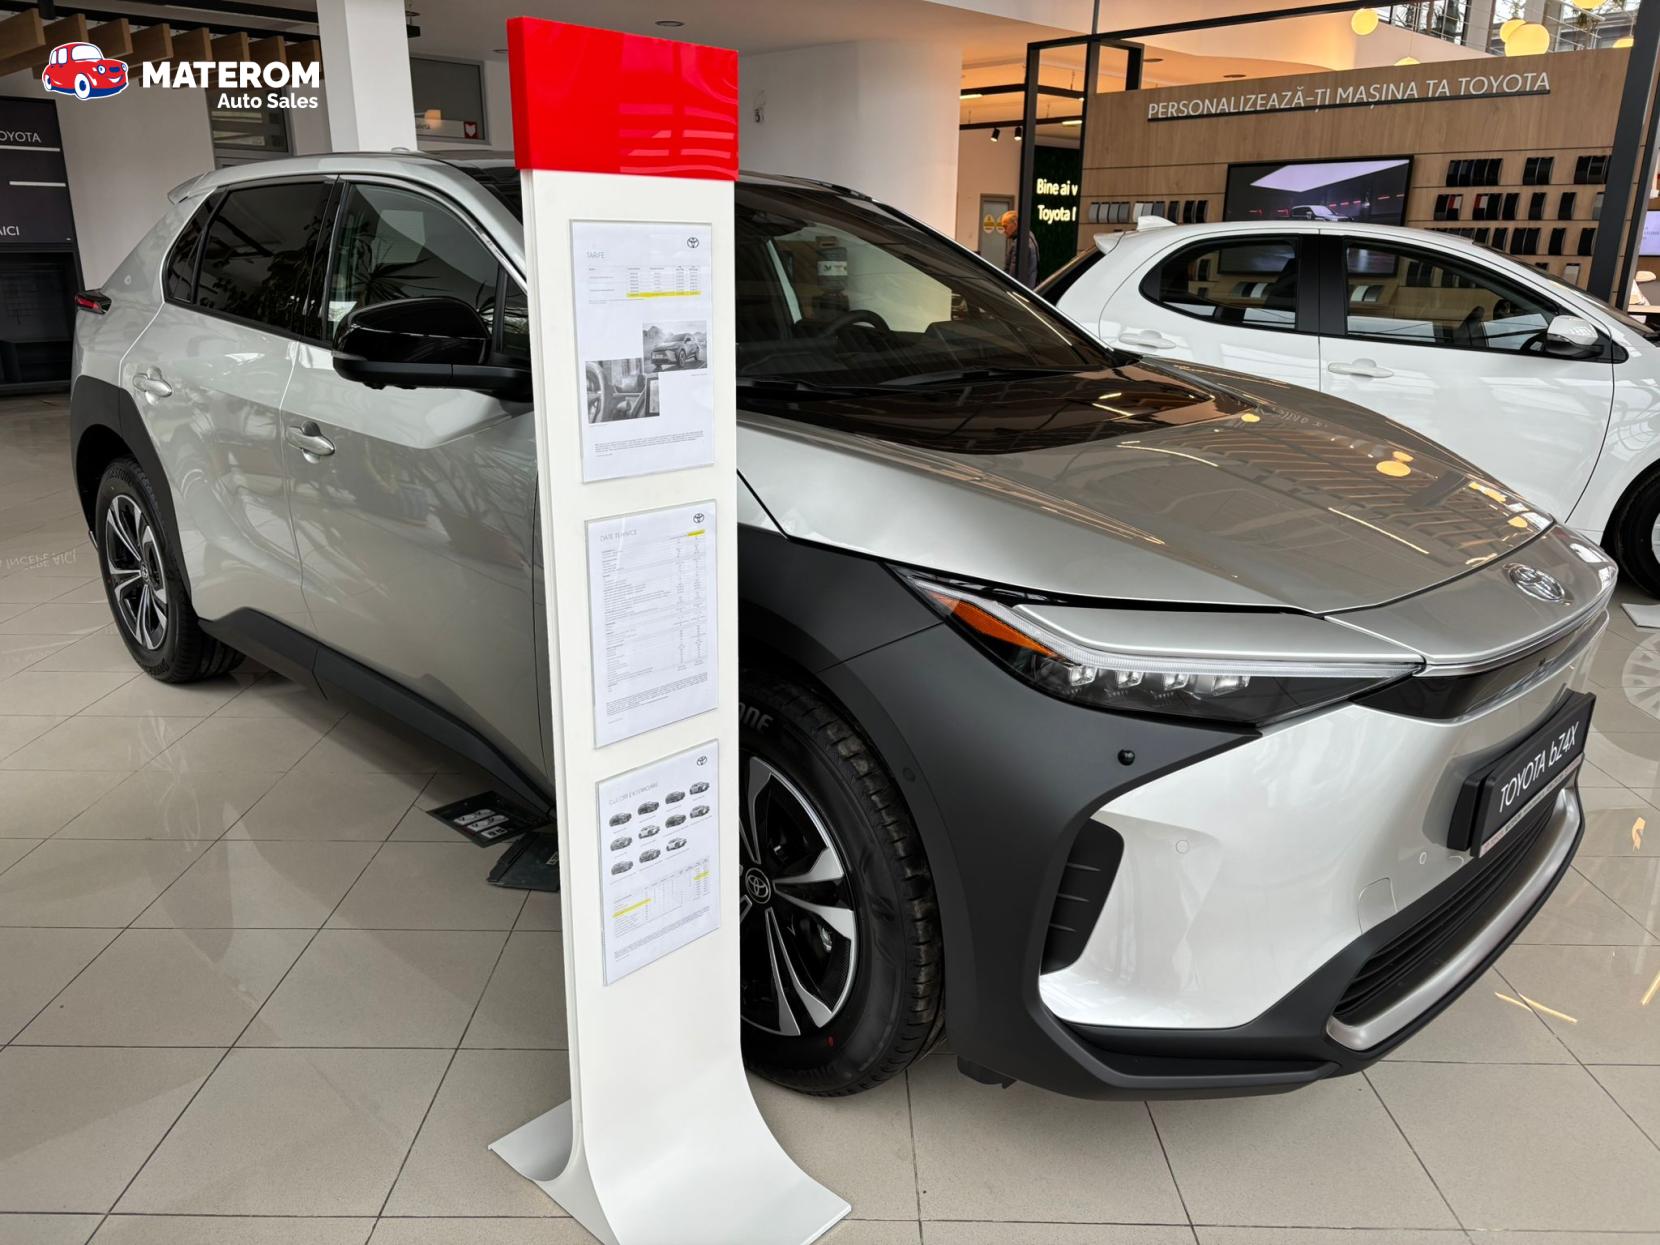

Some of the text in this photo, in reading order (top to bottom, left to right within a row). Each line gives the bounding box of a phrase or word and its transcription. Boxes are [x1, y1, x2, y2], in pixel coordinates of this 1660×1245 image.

[1426, 79, 1450, 98] TA
[1458, 71, 1551, 96] TOYOTA
[0, 130, 42, 144] OYOTA
[1036, 178, 1079, 197] Bine ai v
[1037, 204, 1071, 225] Toyota
[0, 225, 20, 237] ICI
[1499, 749, 1547, 813] TOYOTA
[1548, 721, 1580, 768] bZ4X
